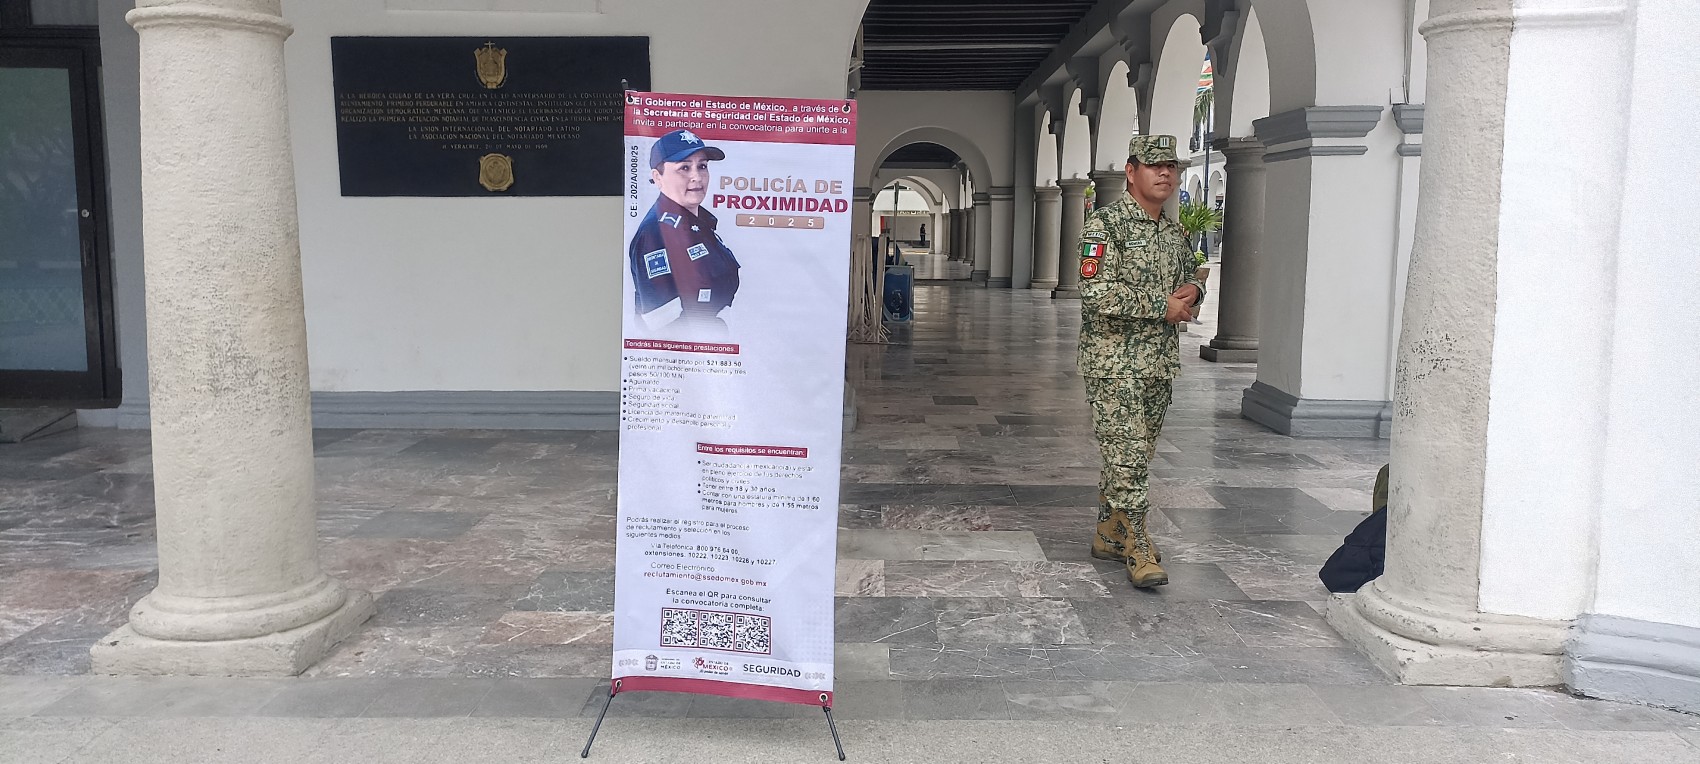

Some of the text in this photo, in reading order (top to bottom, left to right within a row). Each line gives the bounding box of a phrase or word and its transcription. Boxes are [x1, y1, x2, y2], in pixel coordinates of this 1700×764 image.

[645, 98, 687, 107] Gobierno
[690, 100, 702, 108] del
[706, 100, 736, 109] Estado
[740, 102, 750, 110] de
[801, 105, 826, 113] través
[633, 118, 654, 126] invita
[665, 120, 704, 128] participar
[730, 123, 782, 132] convocatoria
[705, 111, 750, 120] Seguridad
[770, 114, 800, 122] Estado
[817, 115, 850, 125] México,
[720, 176, 842, 194] POLICÍA DE
[713, 194, 848, 213] PROXIMIDAD
[666, 588, 697, 596] Escanea
[739, 594, 771, 604] consultar
[681, 598, 728, 607] convocatoria
[730, 602, 765, 611] completa:
[743, 664, 801, 678] SEGURIDAD
